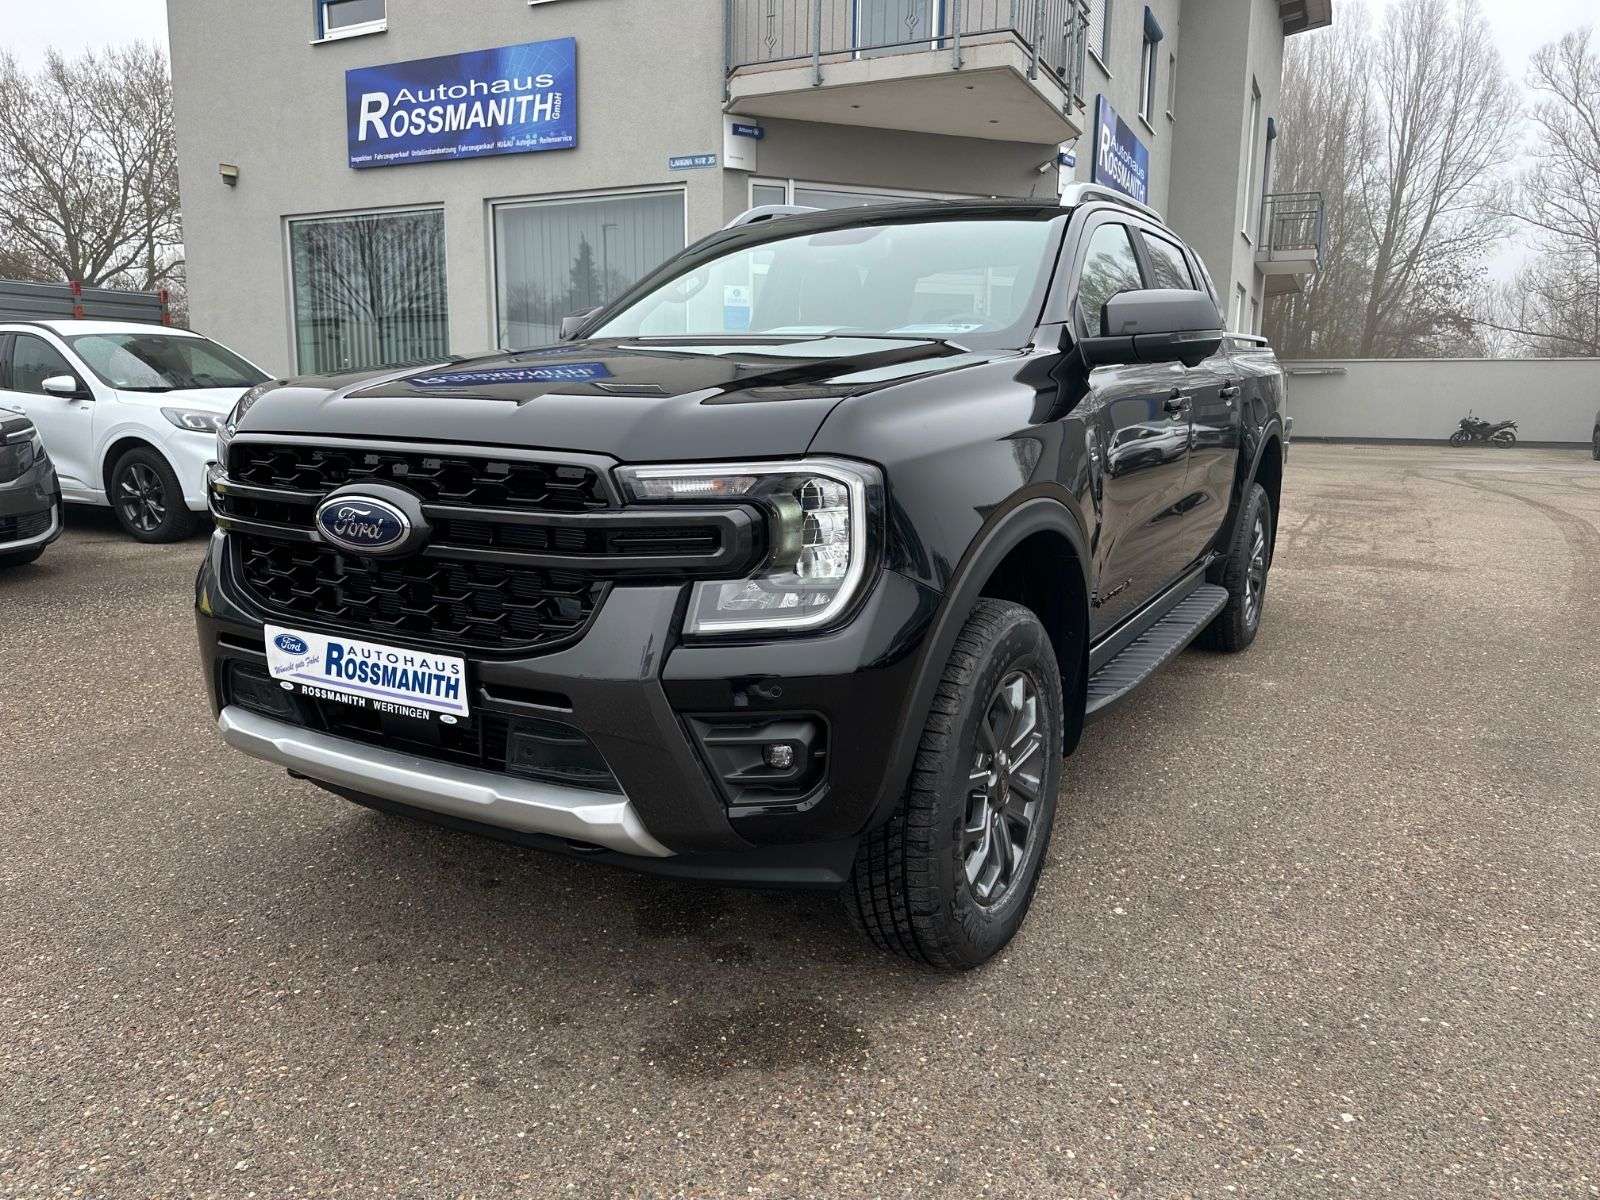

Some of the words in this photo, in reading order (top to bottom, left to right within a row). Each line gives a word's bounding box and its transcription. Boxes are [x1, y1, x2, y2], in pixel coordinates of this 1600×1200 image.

[392, 73, 555, 106] Autohaus
[552, 92, 562, 120] GmbH
[358, 91, 554, 141] ROSSMANITH
[1110, 135, 1145, 180] Autohaus
[333, 506, 384, 540] Ford
[280, 635, 301, 652] Ford
[347, 645, 460, 675] AUTOHAUS
[324, 641, 461, 700] ROSSMANITH
[301, 684, 366, 708] ROSSMANITH
[373, 699, 430, 721] WERTINGEN
